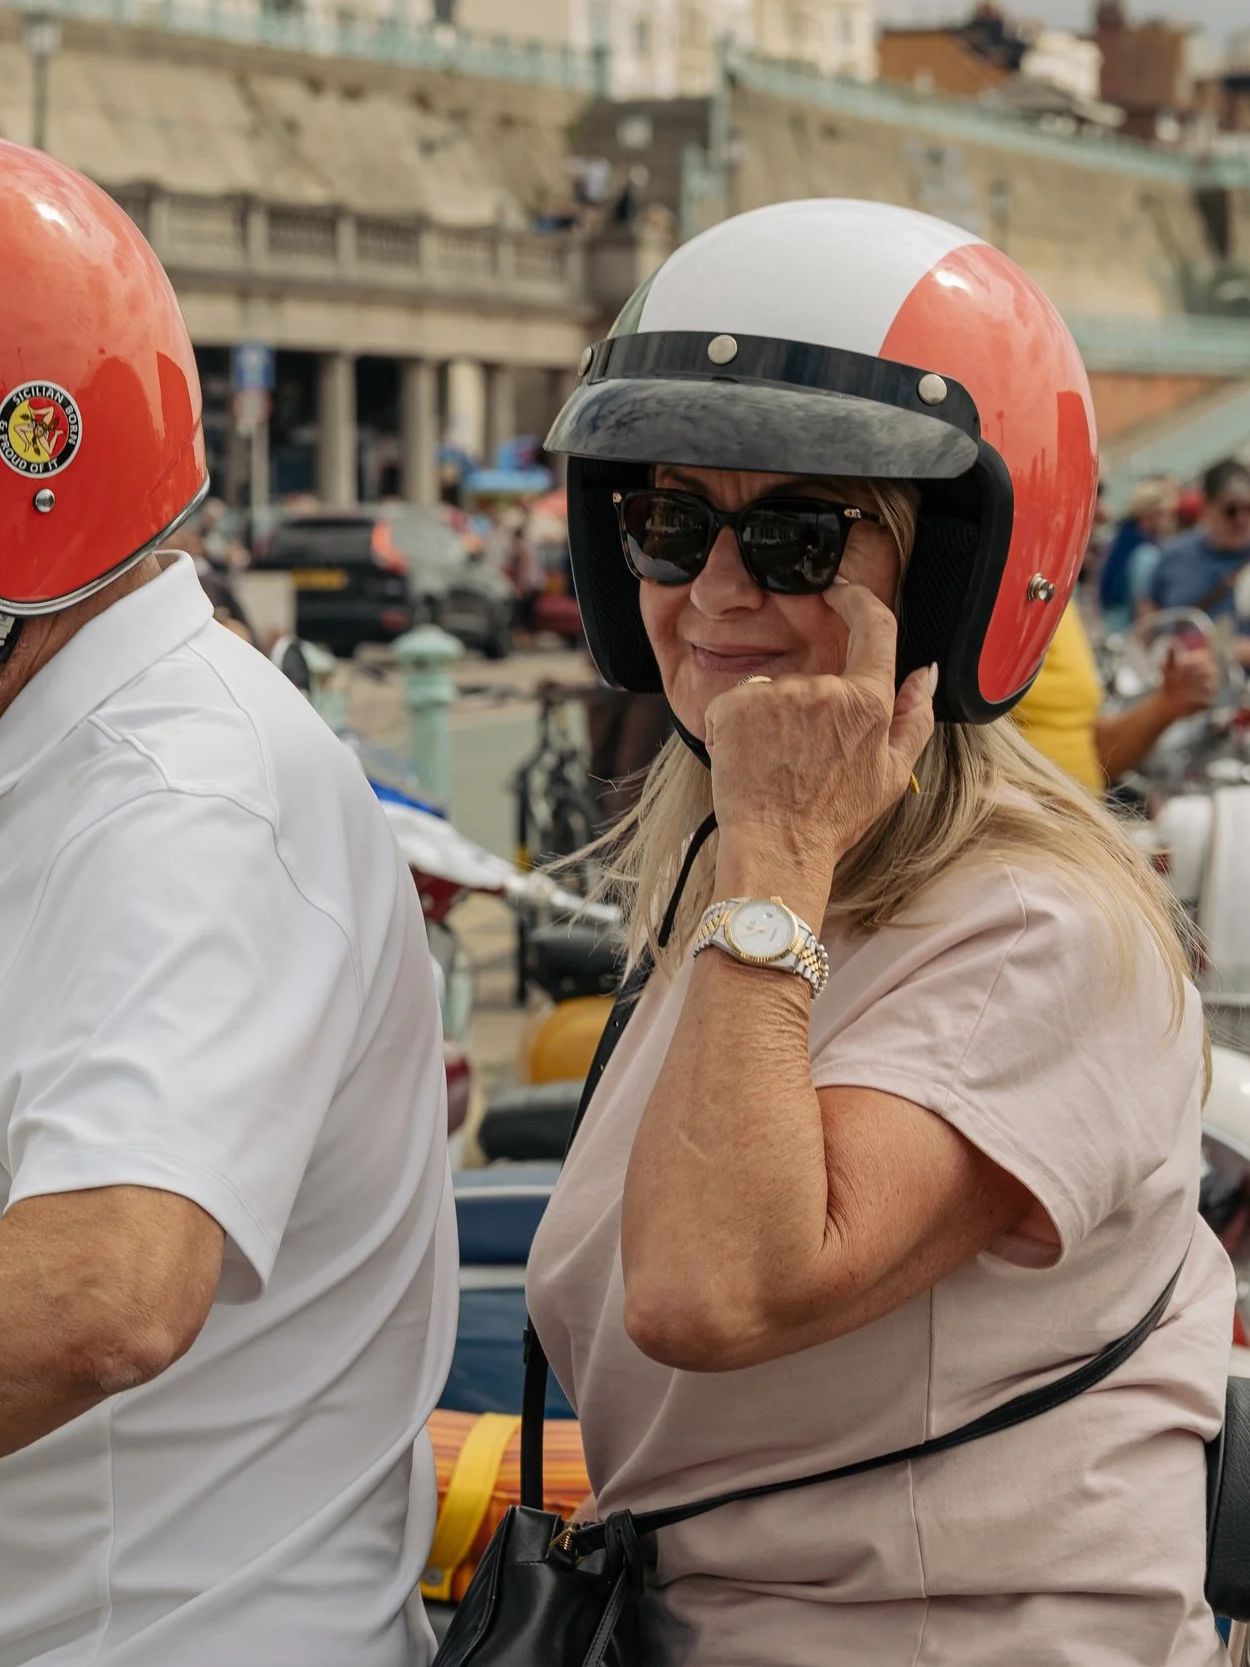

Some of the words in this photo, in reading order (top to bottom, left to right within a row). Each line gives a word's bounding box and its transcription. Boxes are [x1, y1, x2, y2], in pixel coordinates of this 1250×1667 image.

[12, 386, 64, 406] SICILIAN
[65, 404, 78, 445] BORN
[0, 434, 28, 470] PROUD
[30, 462, 44, 474] OF
[49, 457, 59, 471] IT
